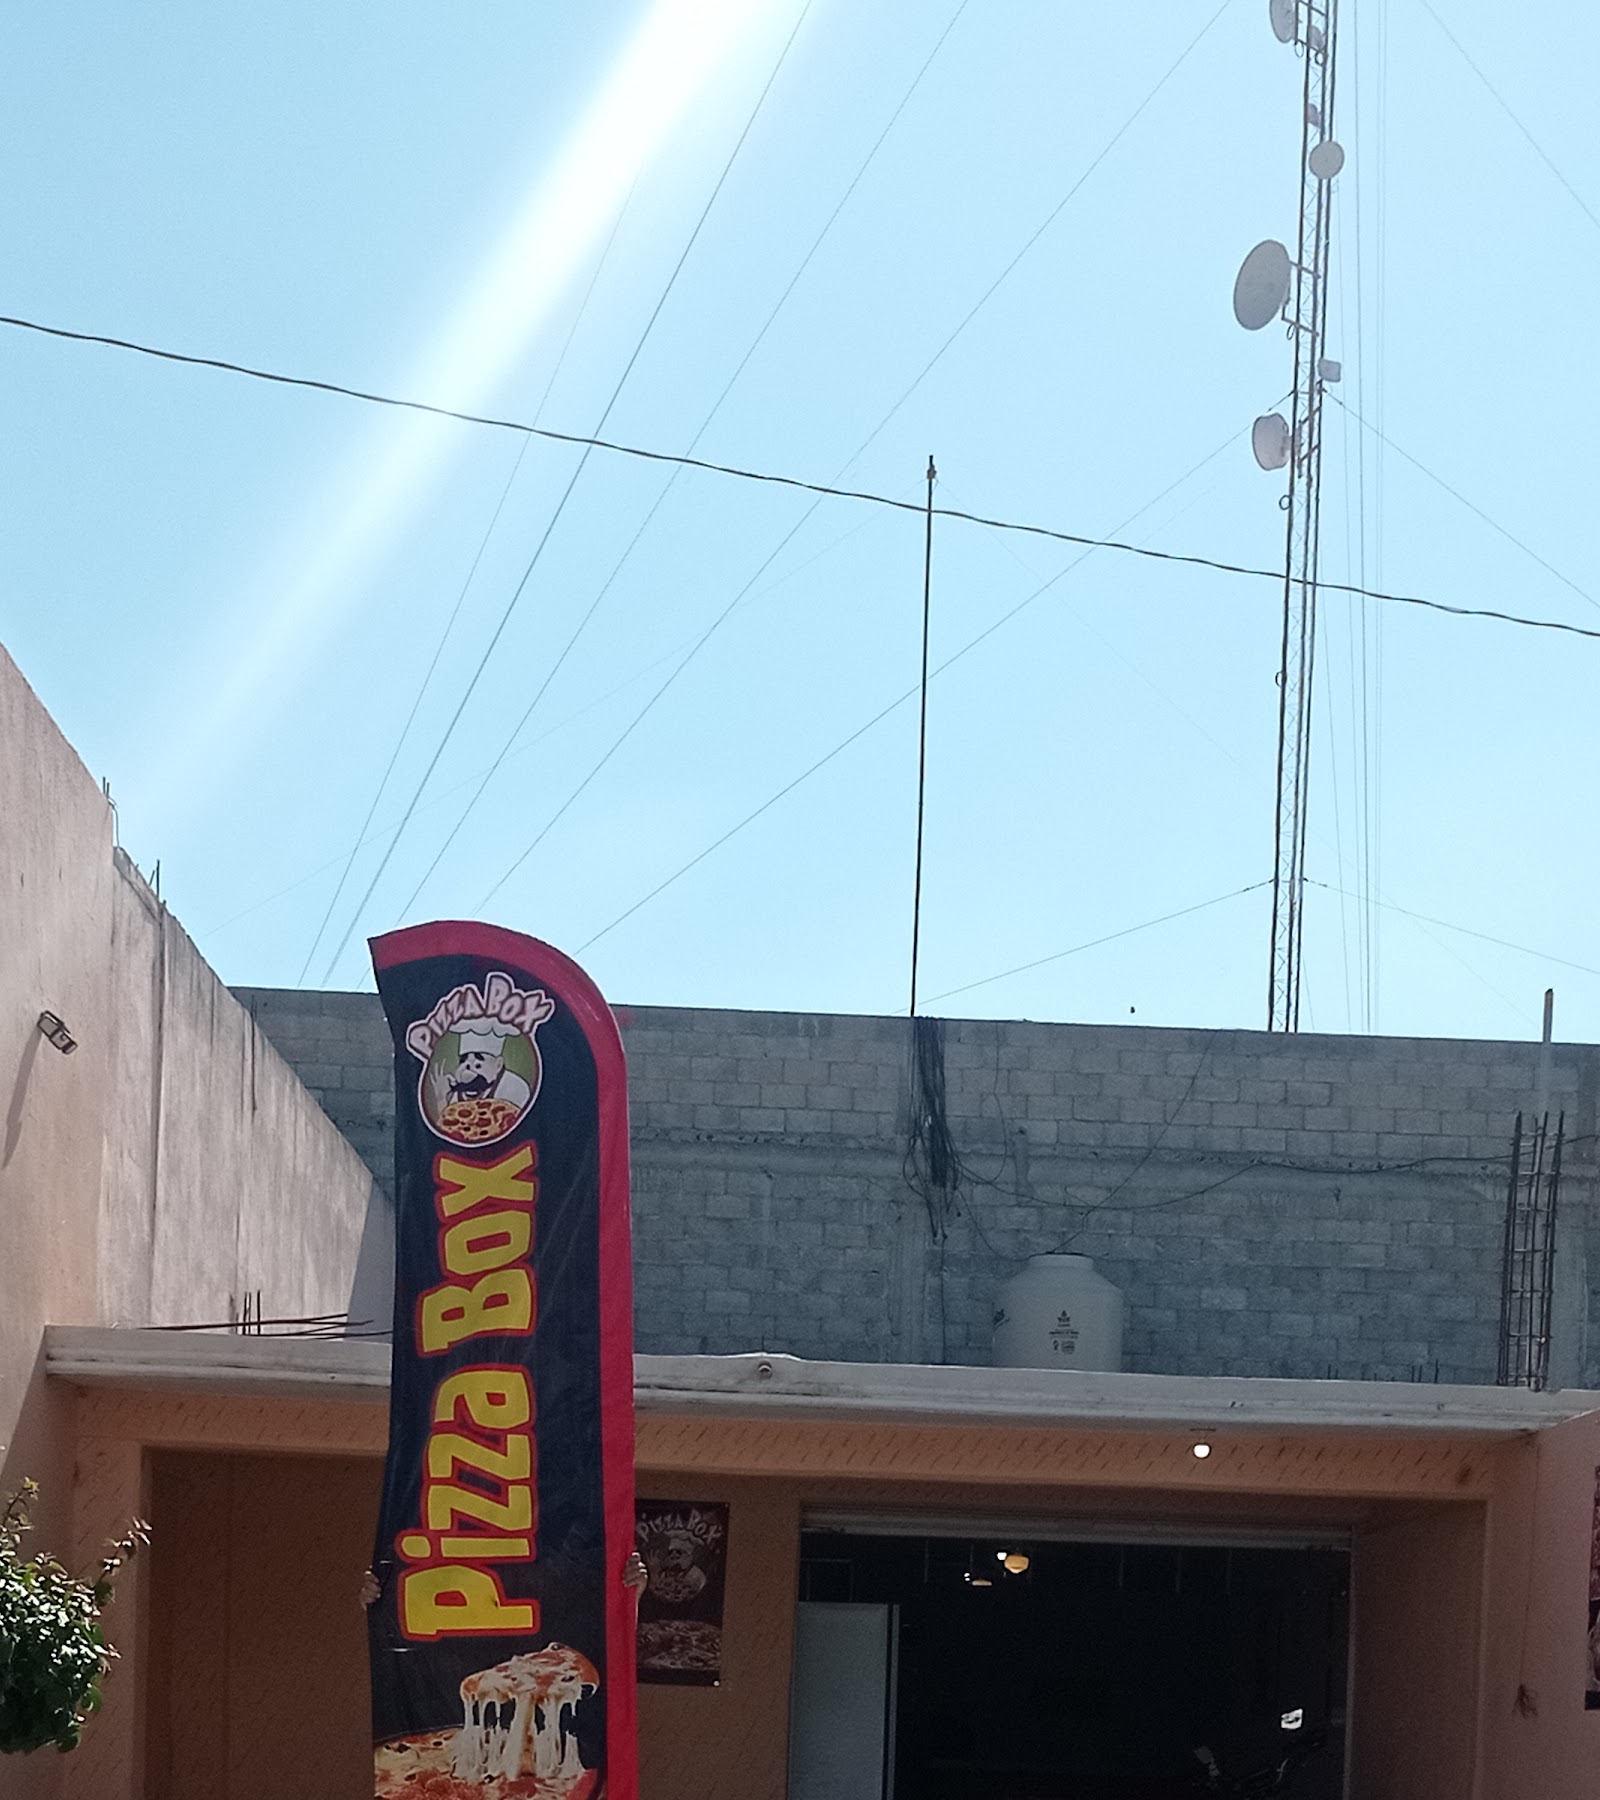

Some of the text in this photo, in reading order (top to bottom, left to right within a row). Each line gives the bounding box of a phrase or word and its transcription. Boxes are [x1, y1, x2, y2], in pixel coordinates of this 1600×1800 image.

[408, 973, 553, 1058] PIZZA BOX
[399, 1145, 536, 1637] Pizza Box
[636, 1509, 722, 1543] PIZZA BOX
